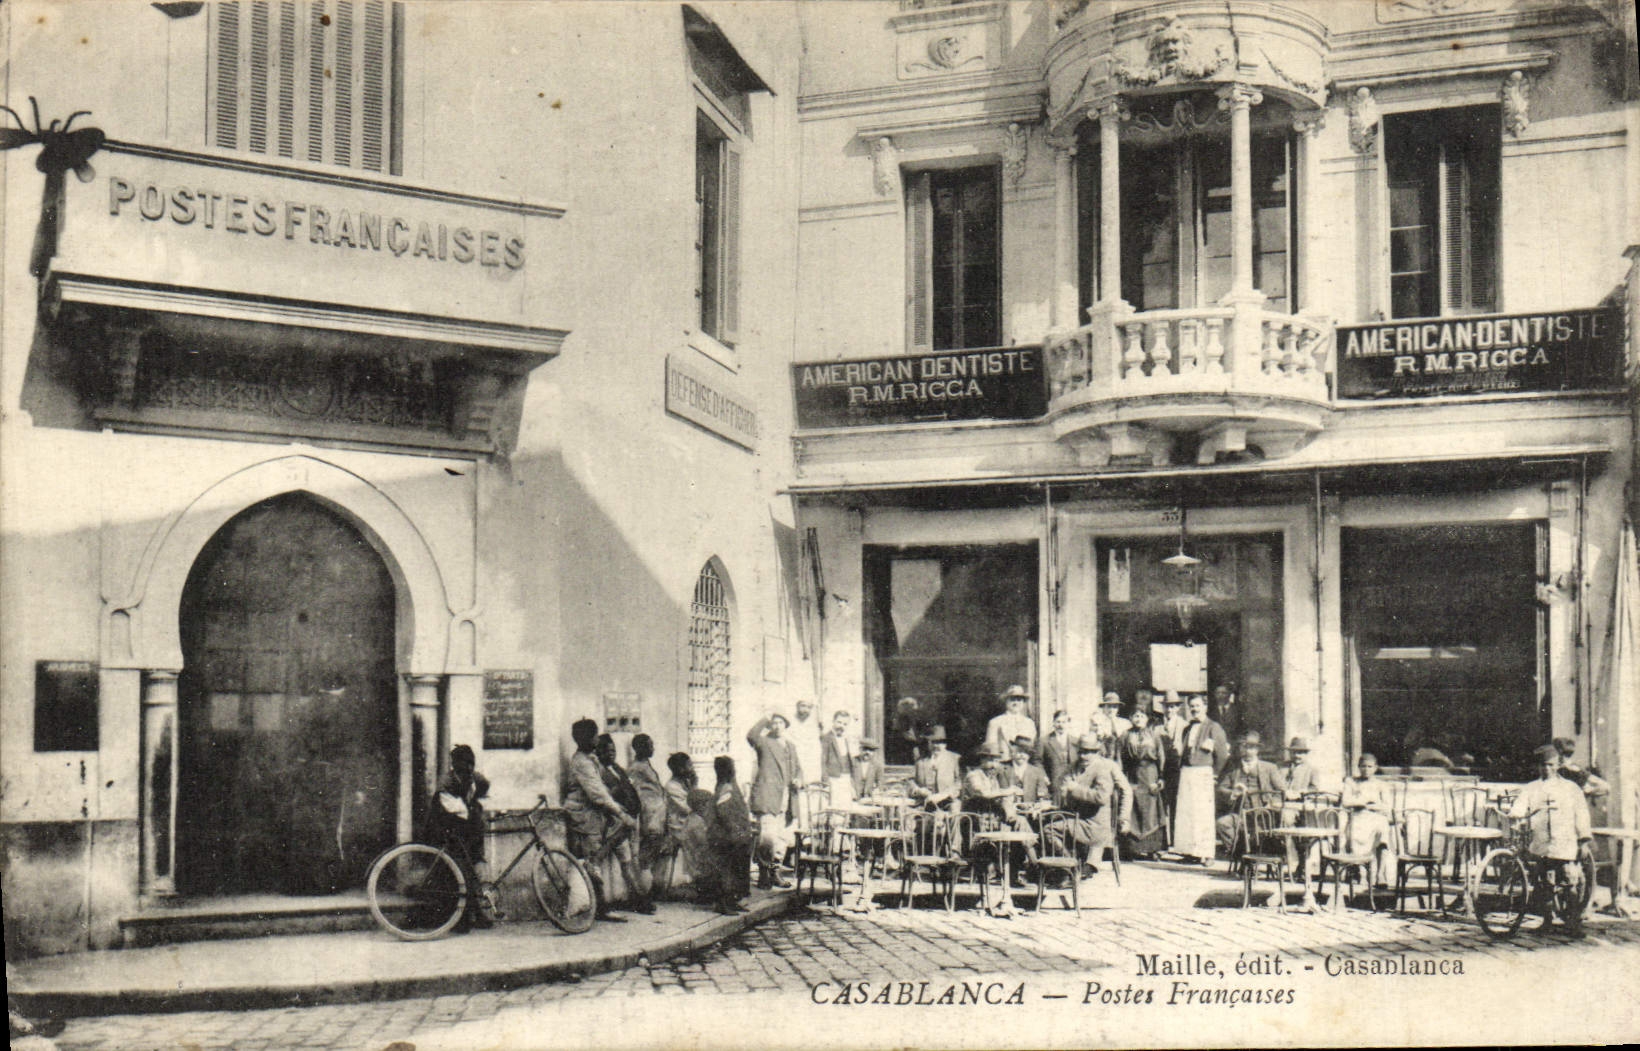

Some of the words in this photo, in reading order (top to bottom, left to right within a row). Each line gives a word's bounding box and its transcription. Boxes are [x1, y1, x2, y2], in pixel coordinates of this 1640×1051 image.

[109, 176, 277, 237] POSTES
[284, 201, 526, 270] FRANÇAISES
[802, 360, 912, 387] AMERICAN
[920, 351, 1035, 379] DENTISTE
